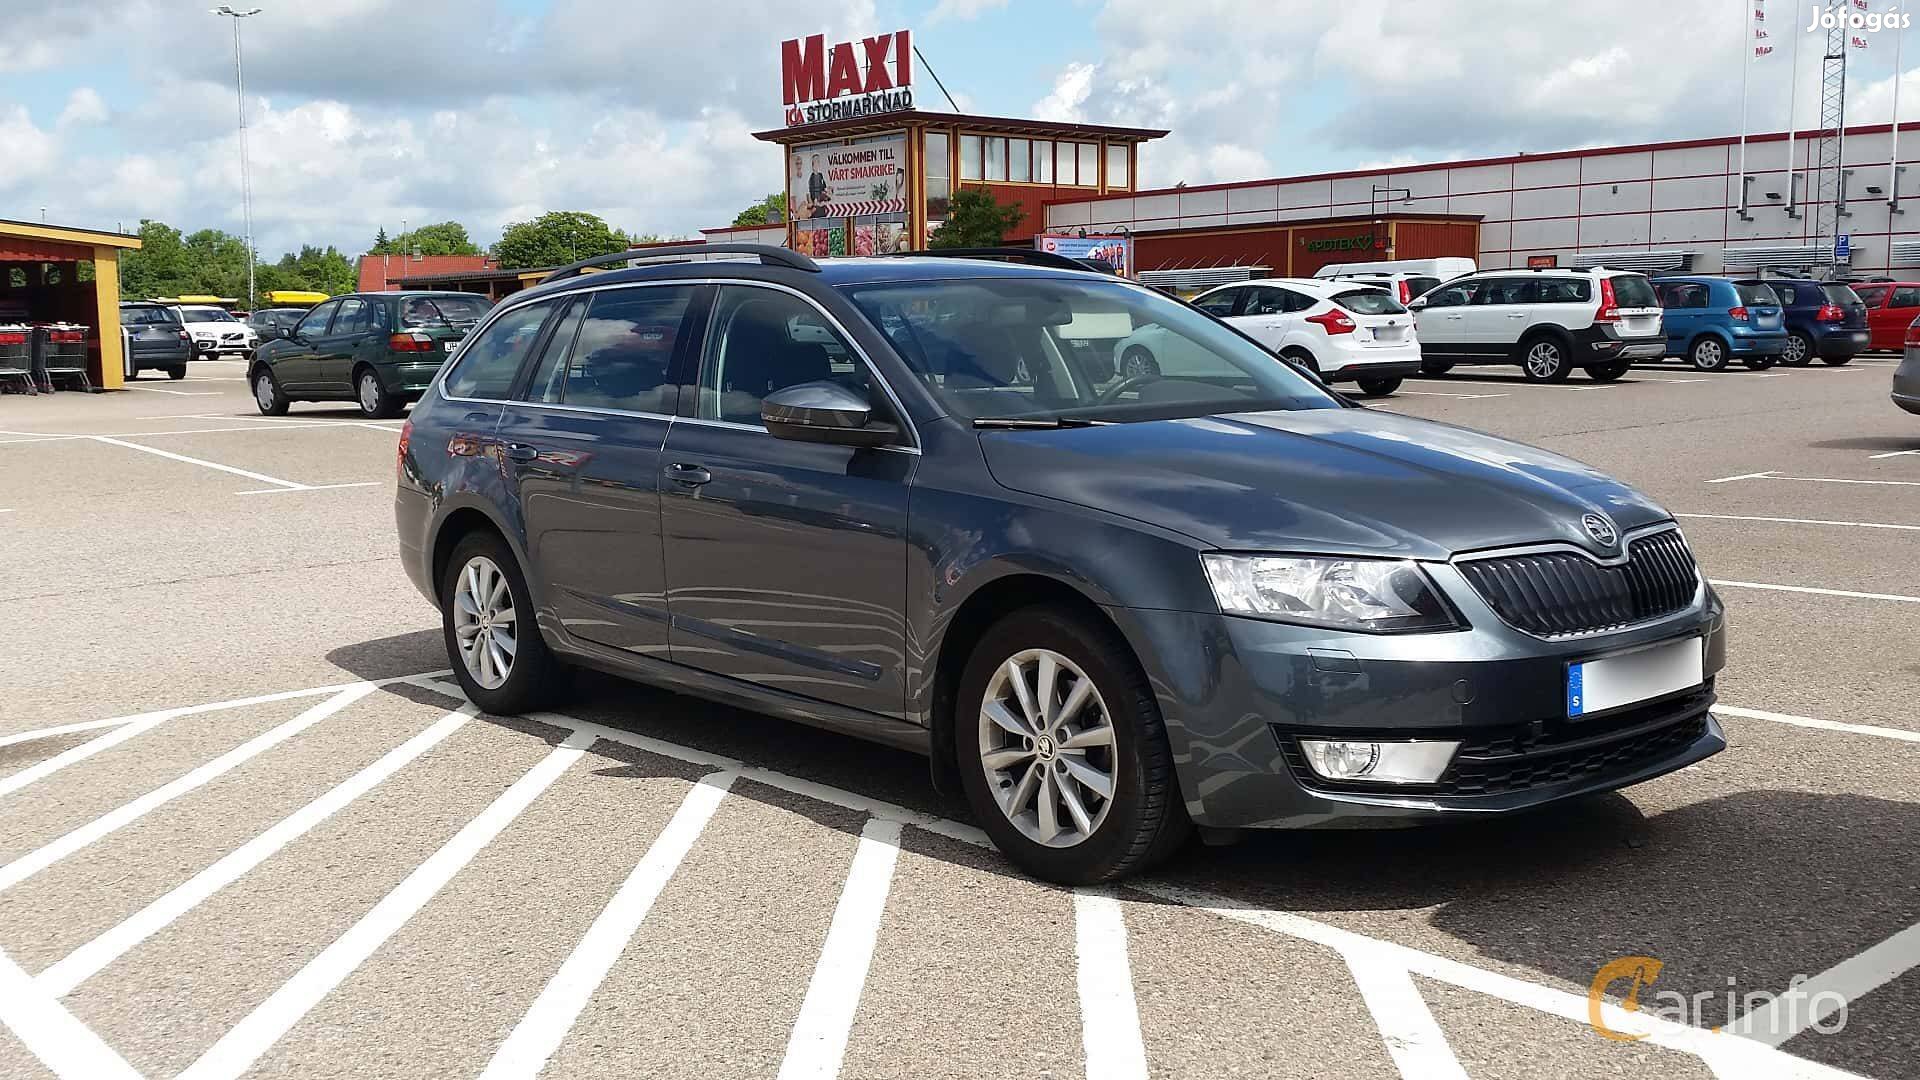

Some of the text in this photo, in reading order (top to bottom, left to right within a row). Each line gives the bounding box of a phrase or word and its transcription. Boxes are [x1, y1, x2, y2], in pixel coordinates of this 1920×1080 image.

[781, 30, 911, 105] MAXI
[786, 91, 912, 126] ICA STORMARKNAD
[828, 147, 895, 166] VÄLKOMMEN TILL
[828, 163, 895, 182] VÅRT SMAKRIKE!
[1308, 238, 1357, 252] APOTEK
[1839, 235, 1847, 246] P
[1572, 695, 1580, 707] S
